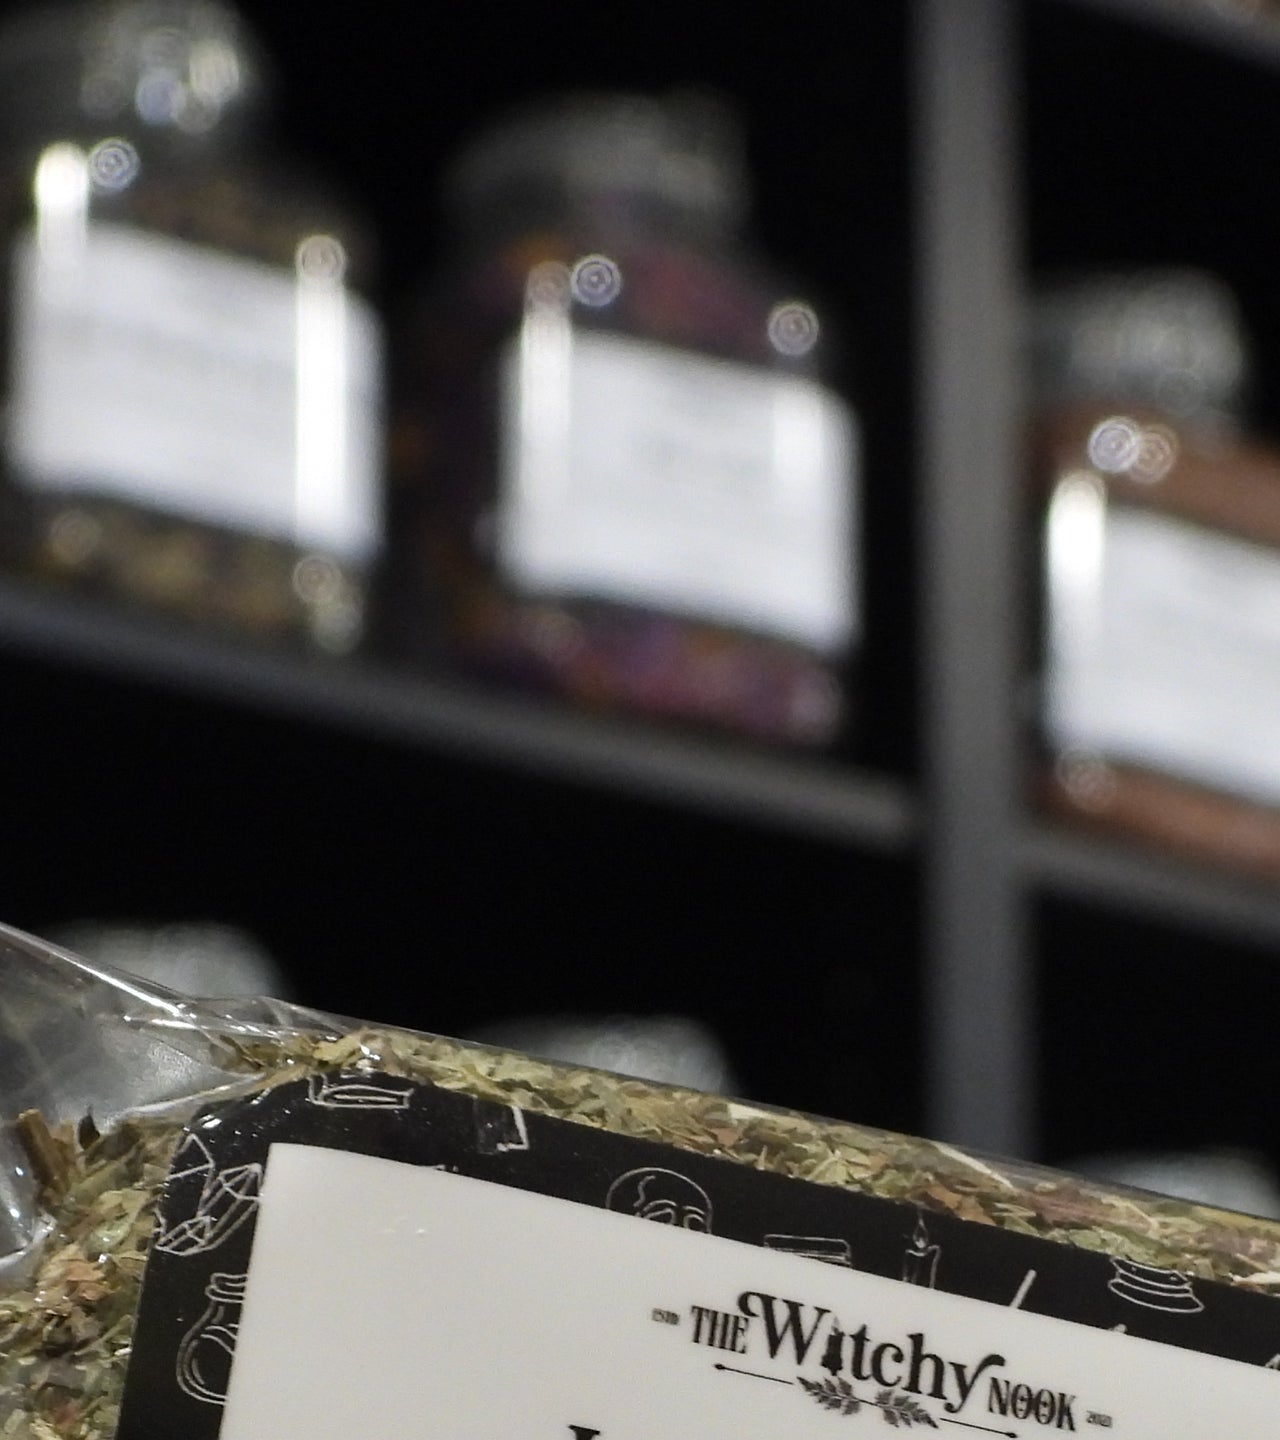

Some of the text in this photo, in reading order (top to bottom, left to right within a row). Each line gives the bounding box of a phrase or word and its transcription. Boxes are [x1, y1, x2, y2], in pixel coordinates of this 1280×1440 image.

[690, 1290, 1077, 1432] THE Witchy NOOK
